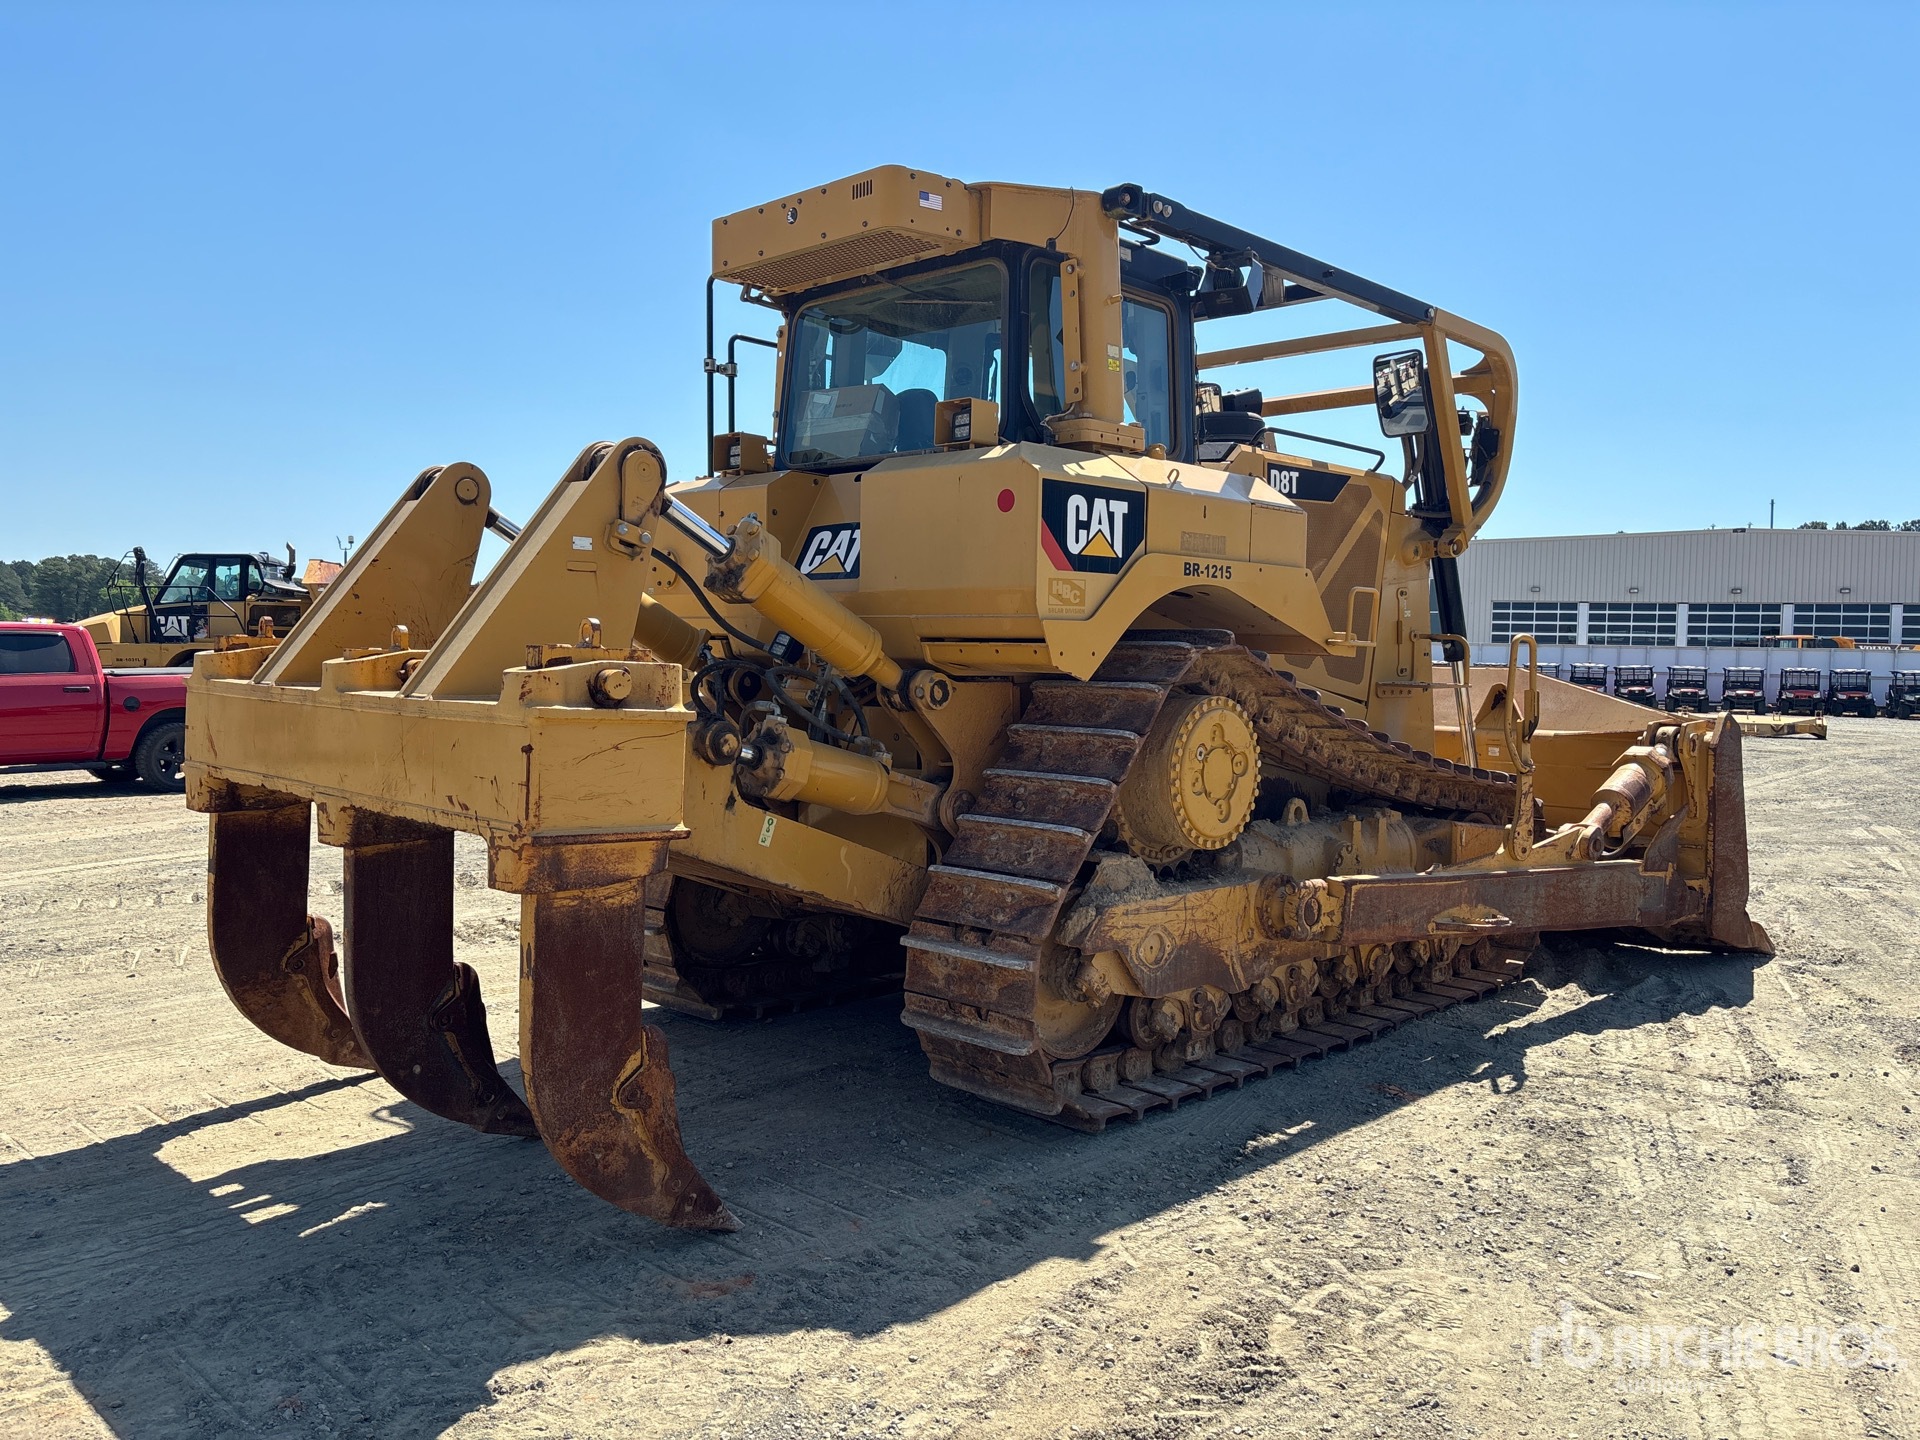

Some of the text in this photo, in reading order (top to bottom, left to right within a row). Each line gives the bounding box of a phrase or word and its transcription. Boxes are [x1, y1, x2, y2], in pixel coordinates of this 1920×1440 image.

[1270, 469, 1299, 494] D8T
[1067, 494, 1128, 558] CAT
[800, 529, 860, 574] CAT
[1183, 562, 1232, 579] BR-1215
[1052, 580, 1080, 603] HBC
